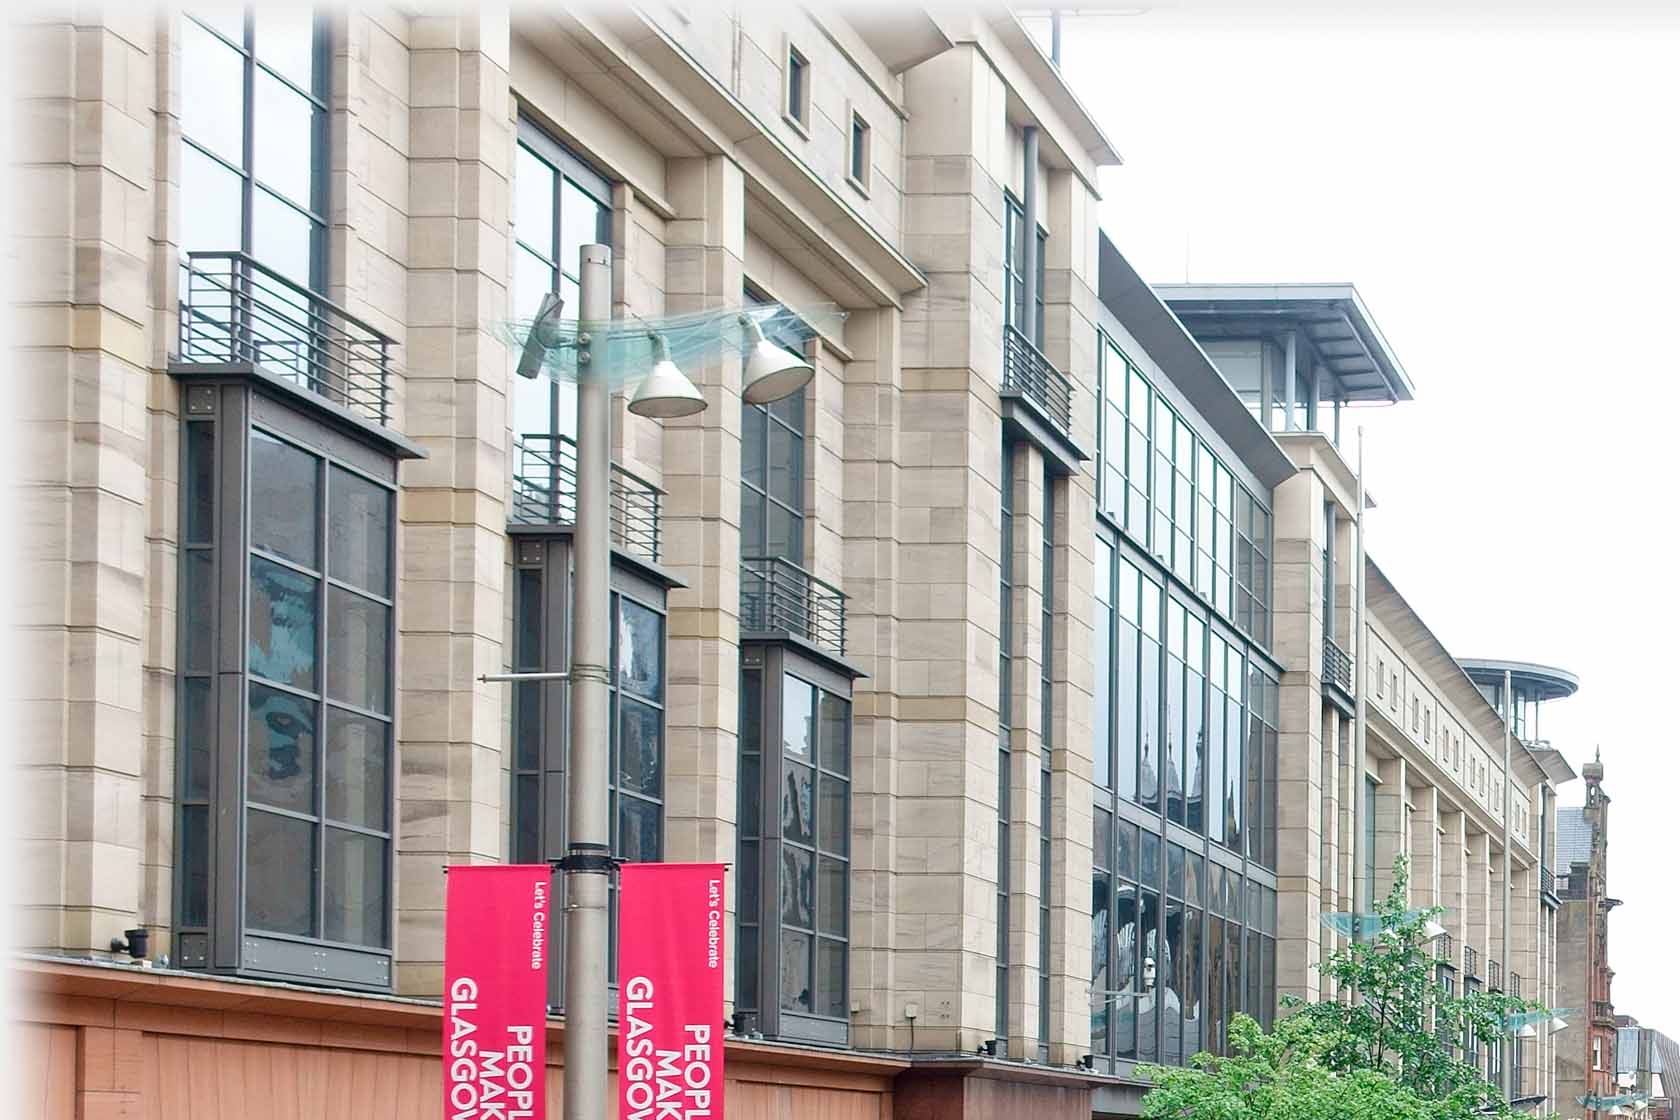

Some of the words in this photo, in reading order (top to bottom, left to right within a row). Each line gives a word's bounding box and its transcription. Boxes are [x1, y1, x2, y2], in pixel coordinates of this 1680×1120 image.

[534, 881, 548, 909] Let's
[708, 879, 721, 907] Let's
[531, 910, 545, 970] Celebrate
[708, 909, 721, 969] Celebrate
